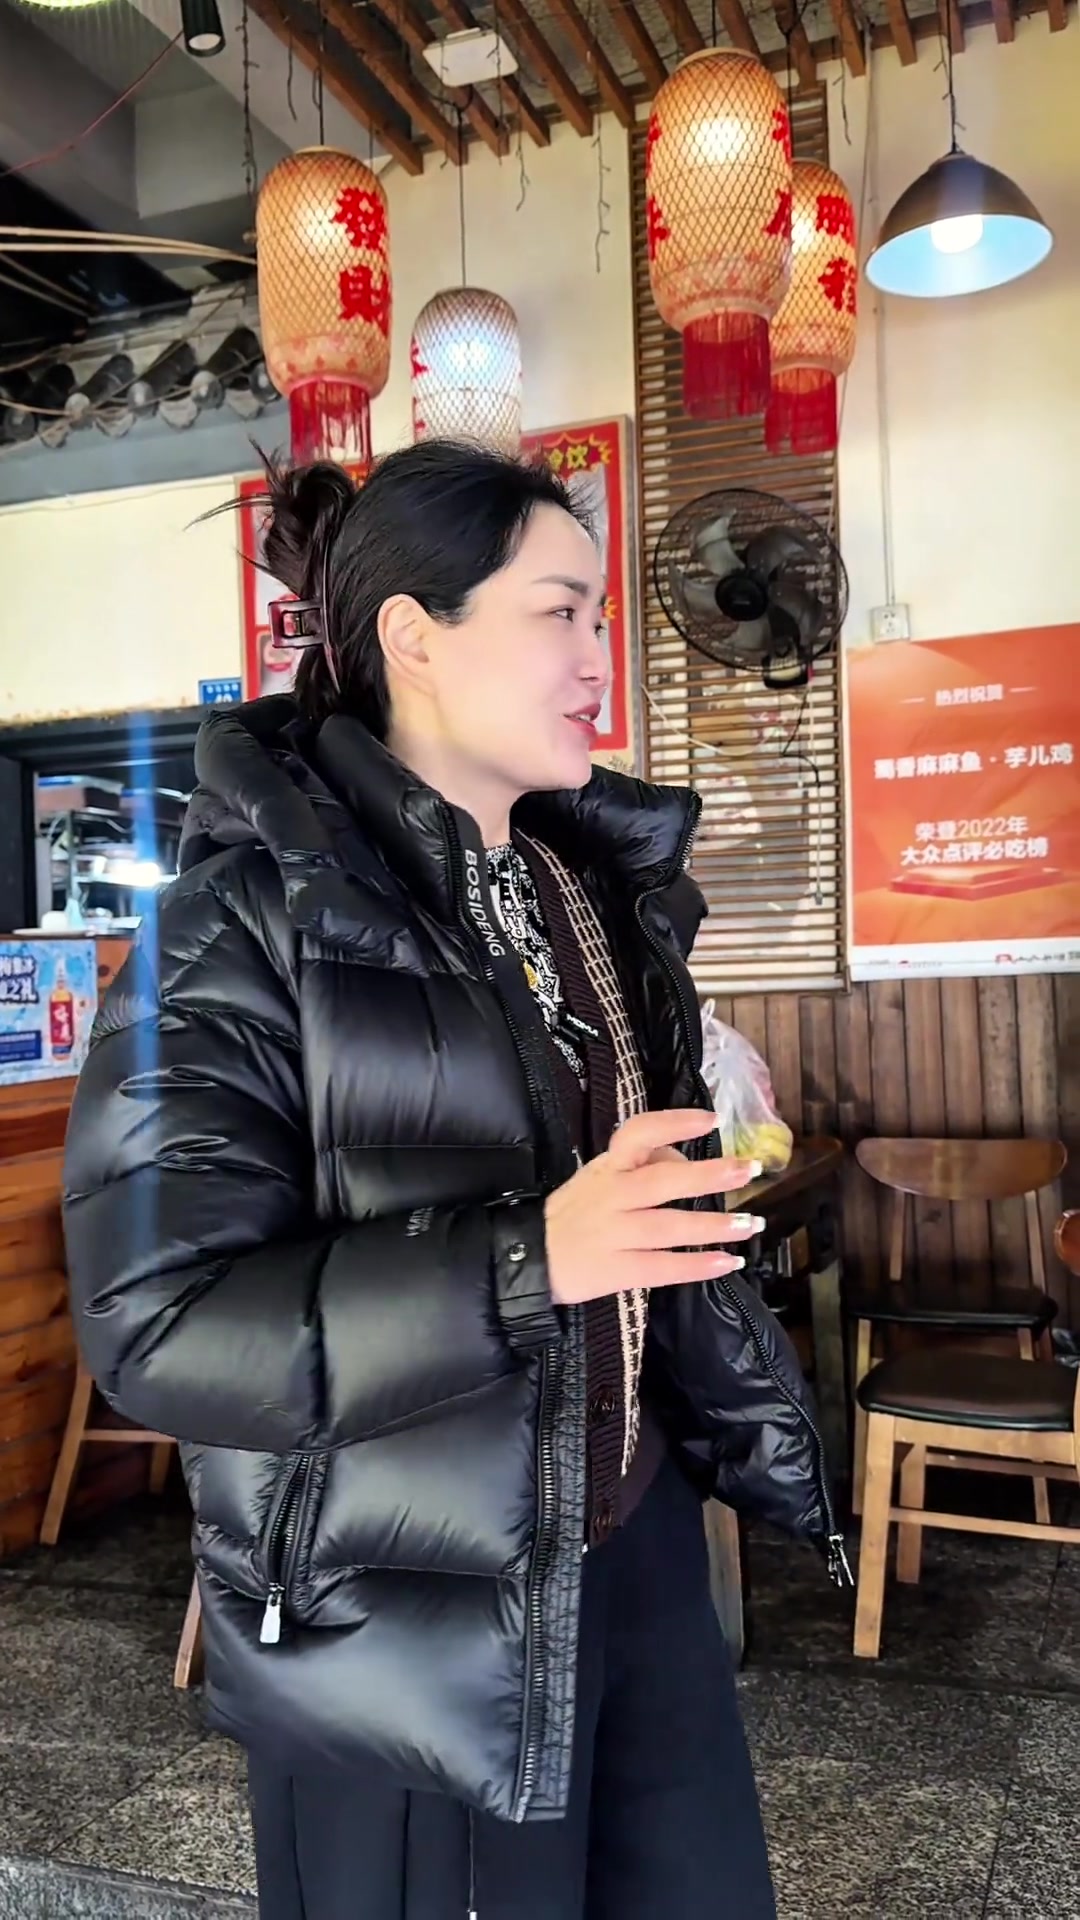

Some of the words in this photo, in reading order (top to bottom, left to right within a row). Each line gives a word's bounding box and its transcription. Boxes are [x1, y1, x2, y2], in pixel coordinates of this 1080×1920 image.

[901, 837, 1048, 866] 大众点评必吃榜
[465, 849, 505, 956] BOSIDENG
